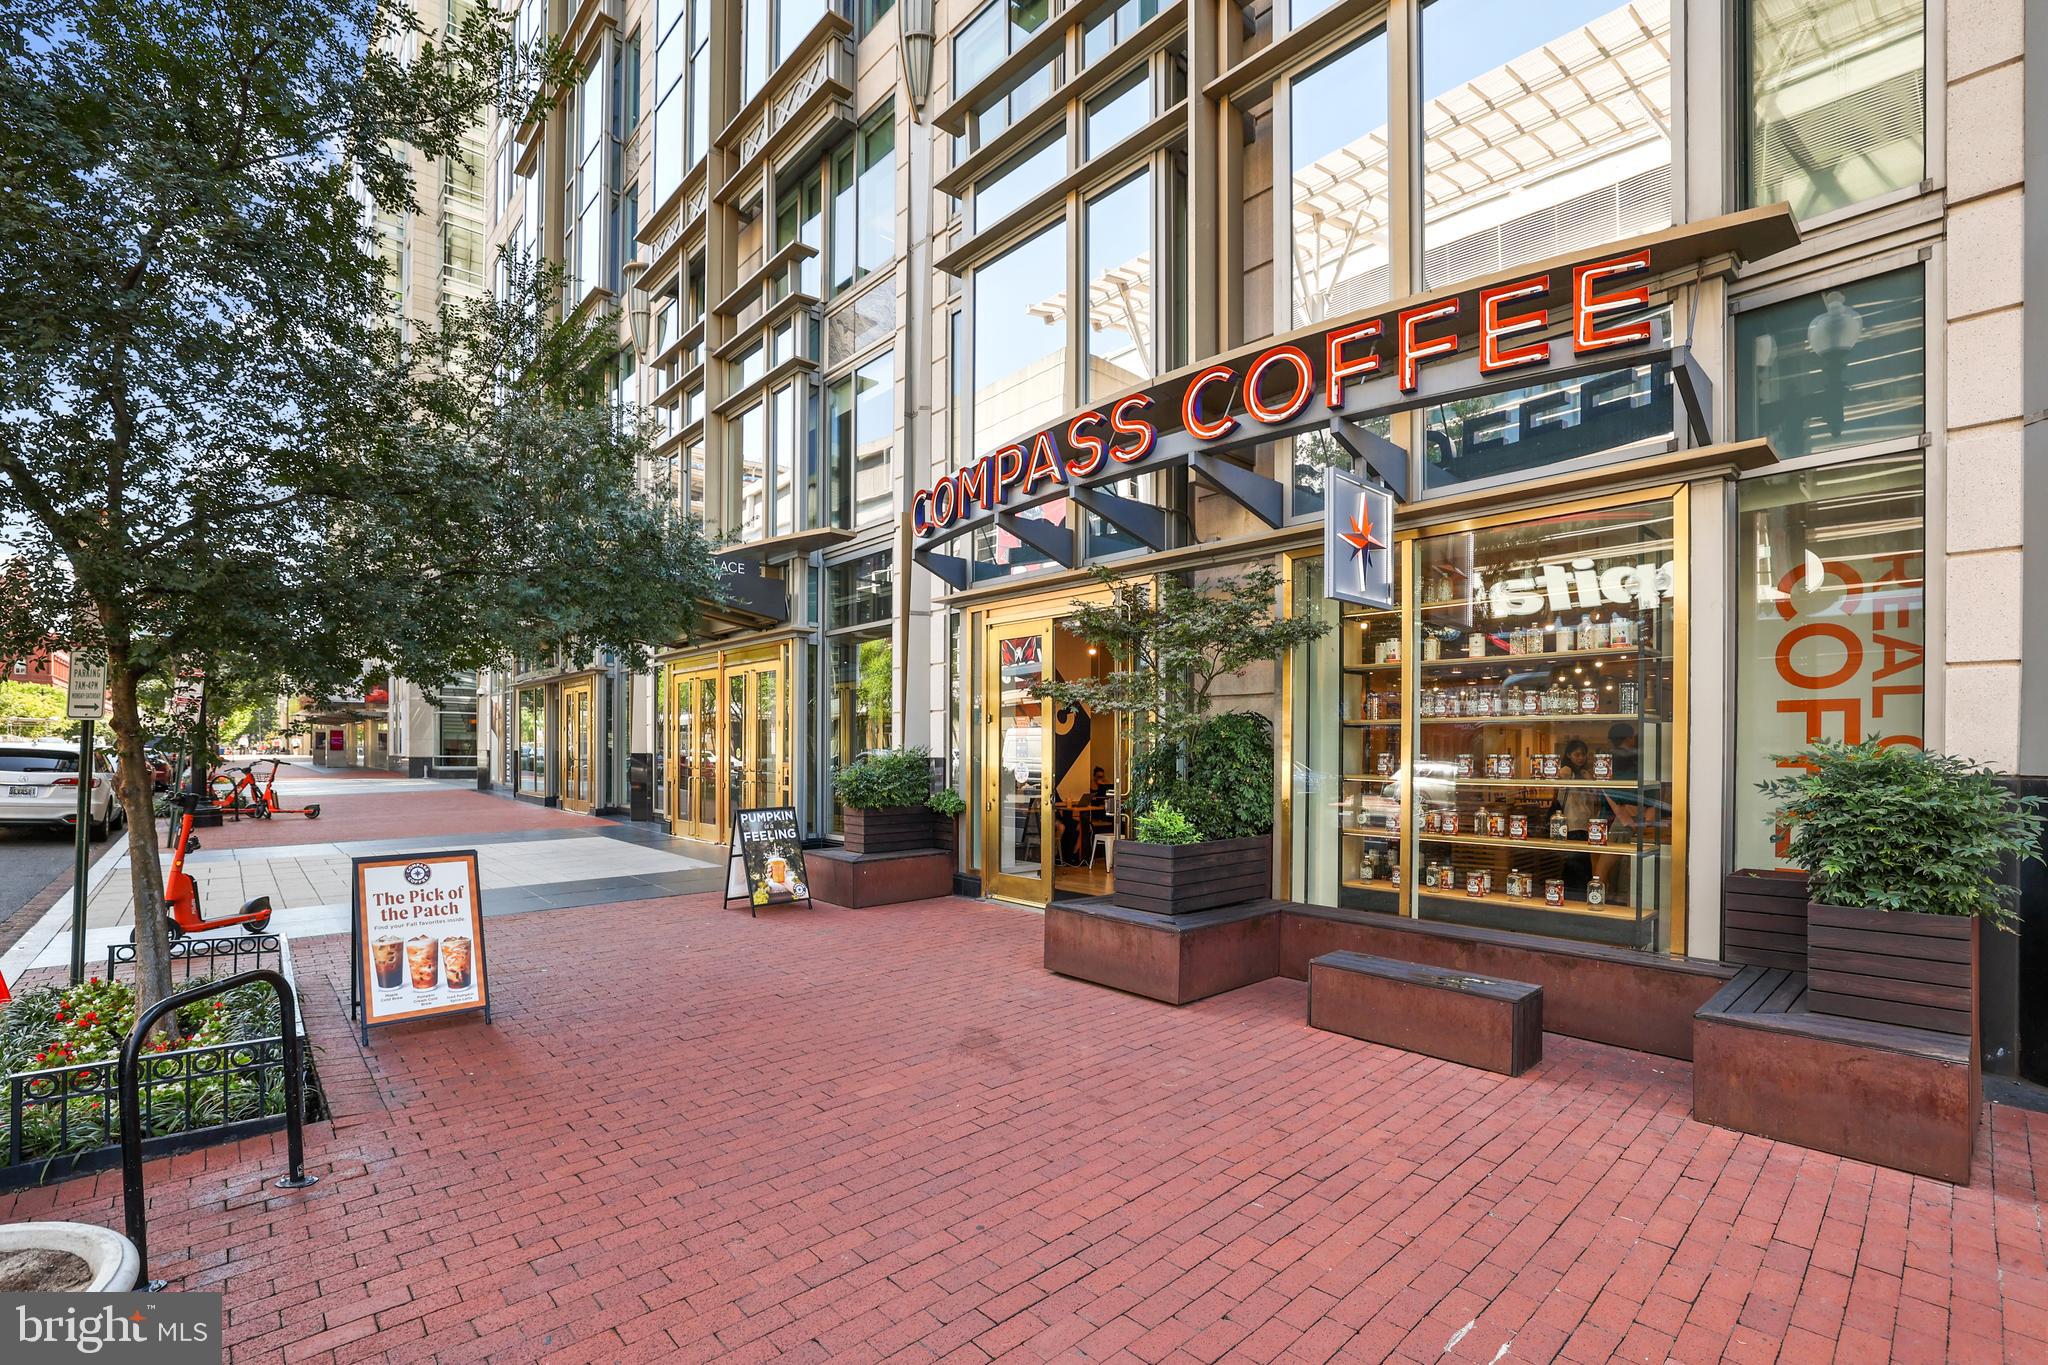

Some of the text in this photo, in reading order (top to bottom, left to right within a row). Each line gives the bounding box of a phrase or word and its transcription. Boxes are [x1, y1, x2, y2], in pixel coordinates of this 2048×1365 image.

[911, 248, 1652, 539] COMPASS COFFEE
[1872, 552, 1924, 718] REAL
[74, 668, 101, 678] PARKING
[74, 681, 99, 690] 7AM-4PM
[740, 811, 794, 823] PUMPKIN
[743, 828, 797, 842] FEELING
[406, 863, 429, 873] COMPASS
[407, 876, 429, 884] COFFEE
[372, 885, 464, 906] The Pick of
[380, 902, 459, 921] the Patch
